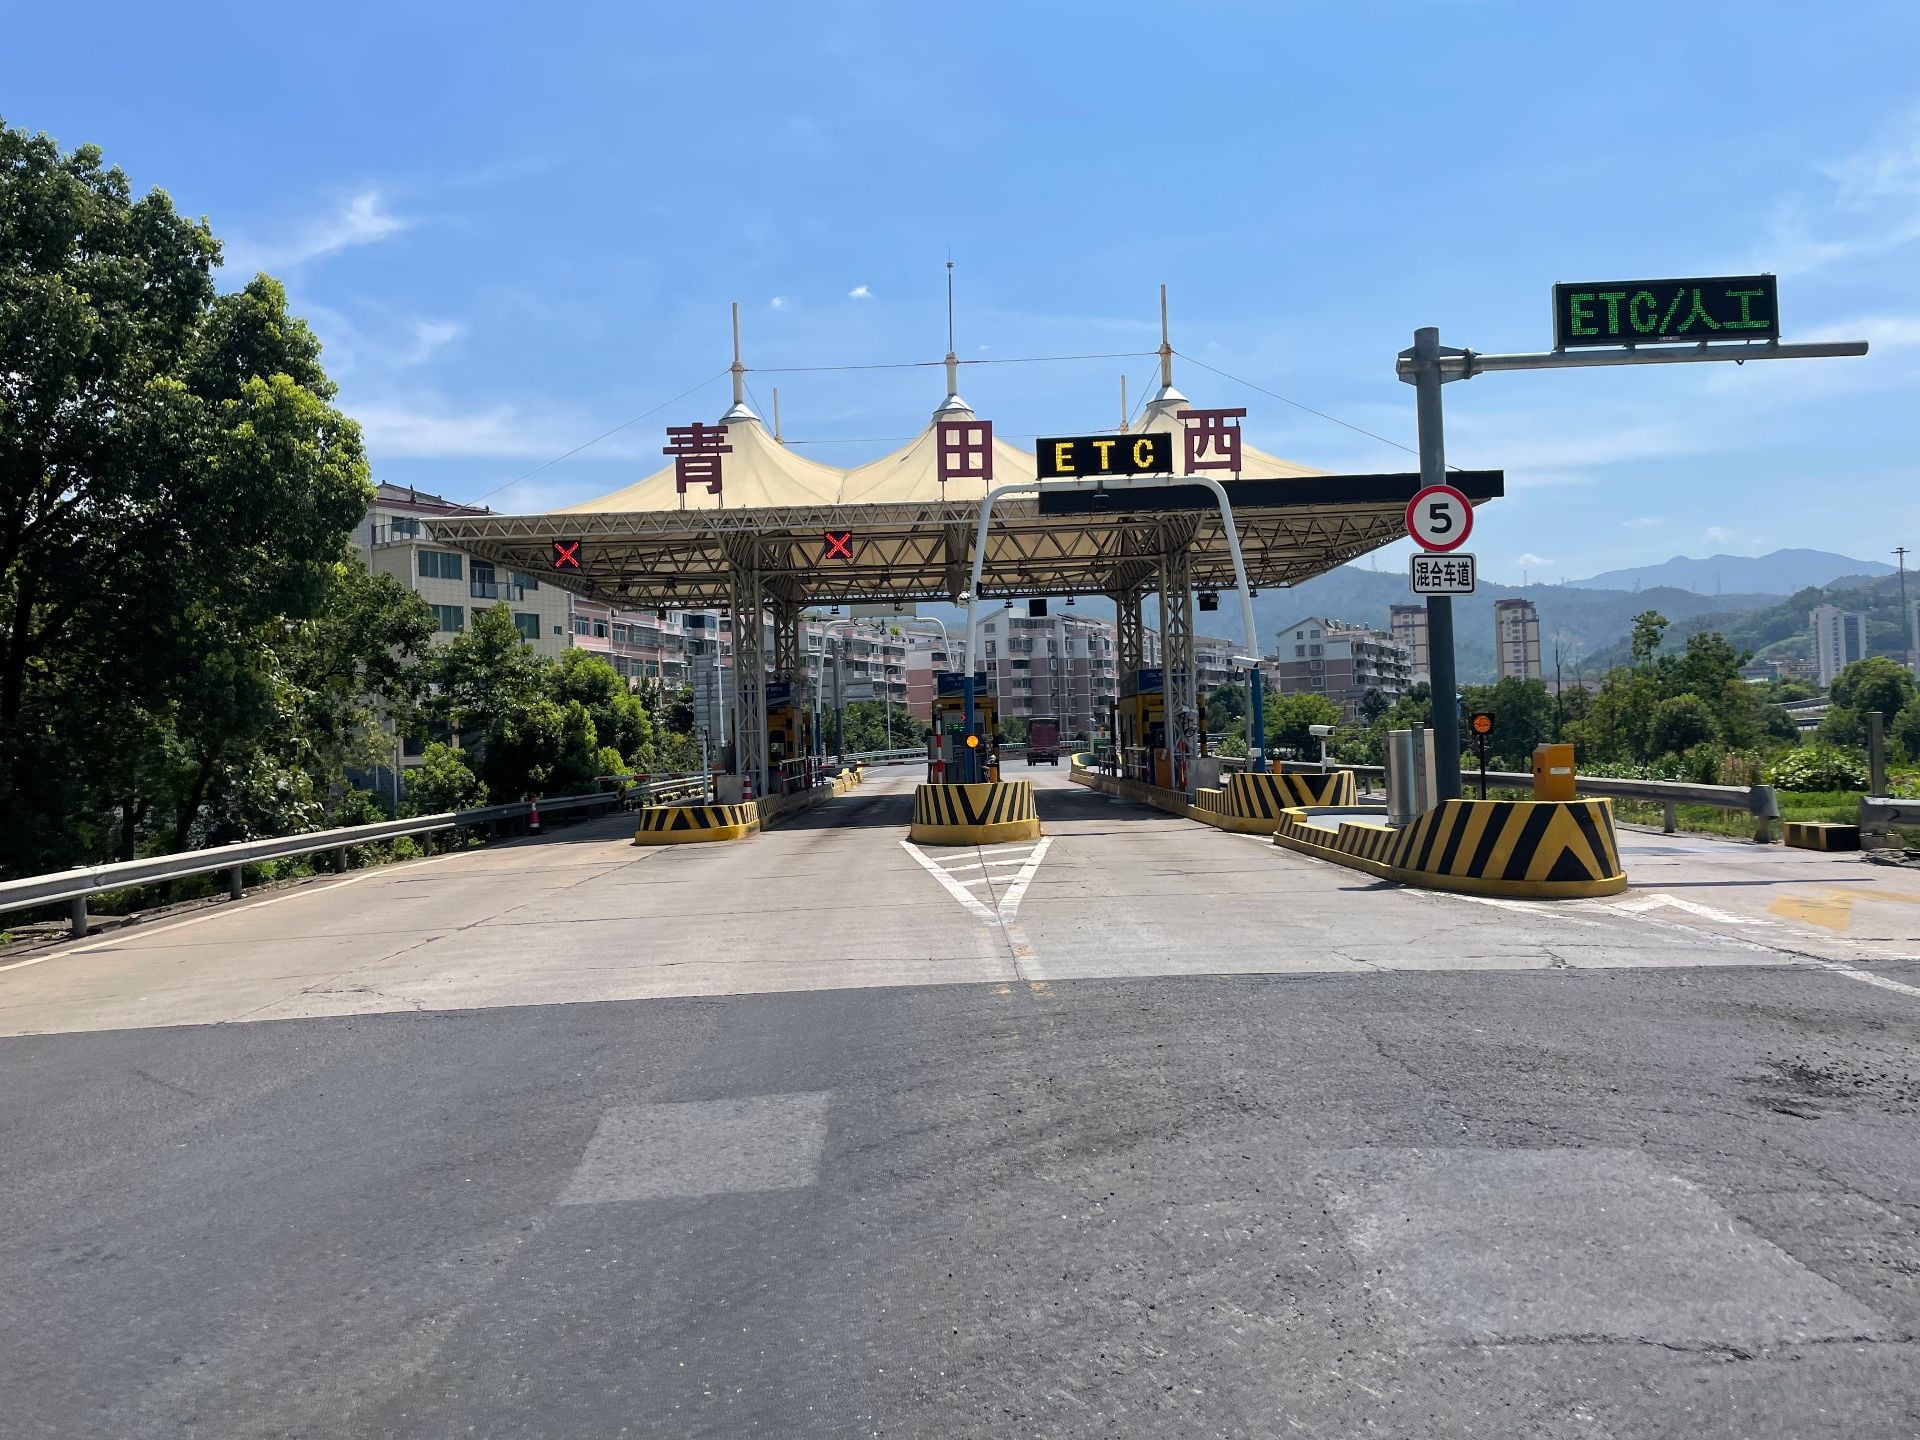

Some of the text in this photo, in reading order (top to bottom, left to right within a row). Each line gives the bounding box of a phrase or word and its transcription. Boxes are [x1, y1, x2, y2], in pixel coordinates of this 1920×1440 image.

[1569, 287, 1770, 336] ETC/人工
[1055, 438, 1154, 472] ETC
[1429, 502, 1453, 534] 5
[1416, 561, 1471, 588] 混合车道
